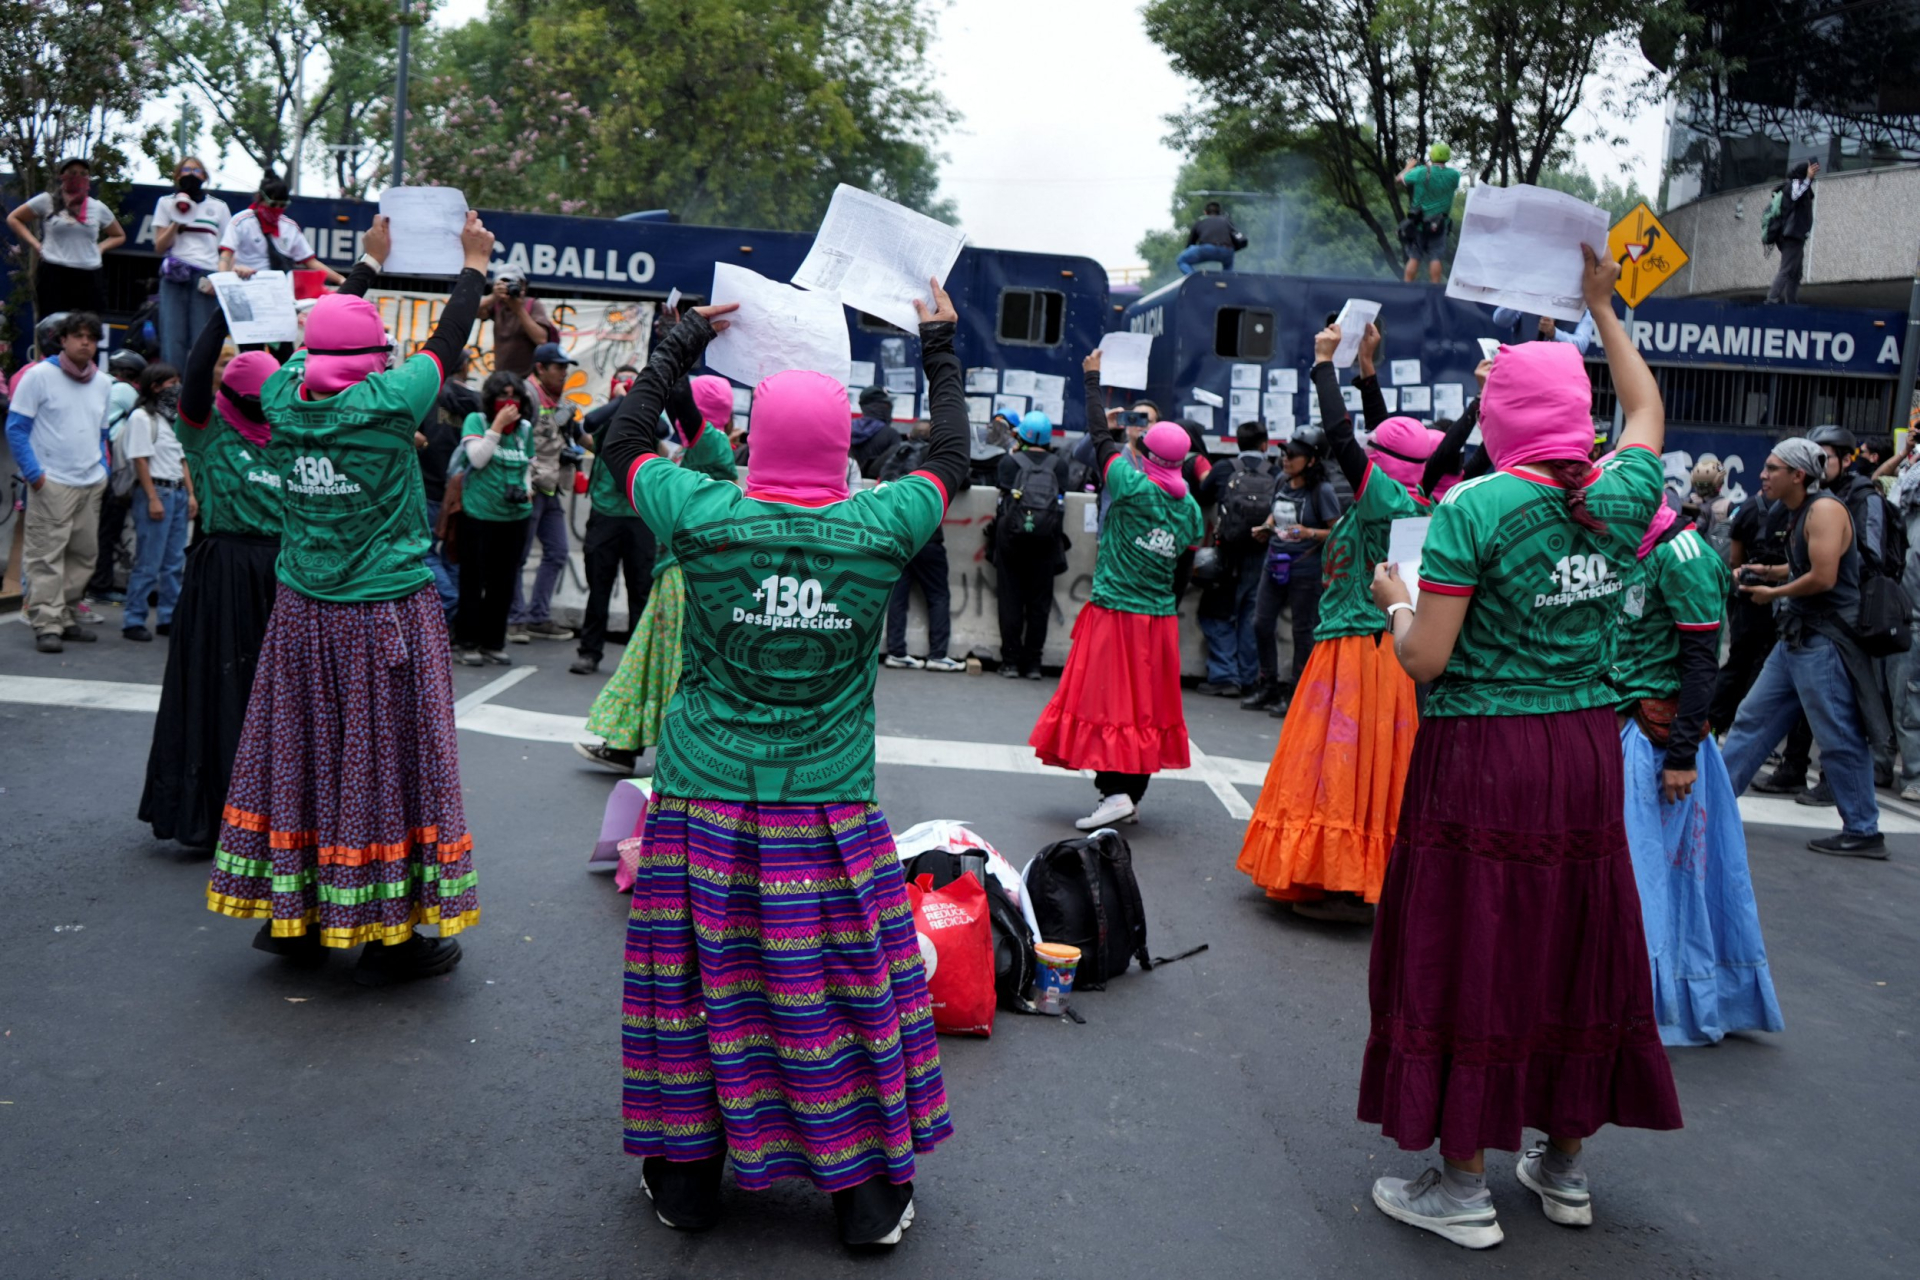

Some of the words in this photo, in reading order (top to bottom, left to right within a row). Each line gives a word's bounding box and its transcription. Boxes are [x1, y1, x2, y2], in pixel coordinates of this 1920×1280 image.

[292, 456, 335, 487] +130
[1550, 554, 1607, 593] +130
[752, 575, 823, 619] +130
[820, 602, 840, 613] MIL
[732, 606, 853, 631] Desaparecidxs
[922, 902, 958, 914] REUSA
[925, 908, 969, 921] REDUCE
[929, 915, 976, 930] RECICLA
